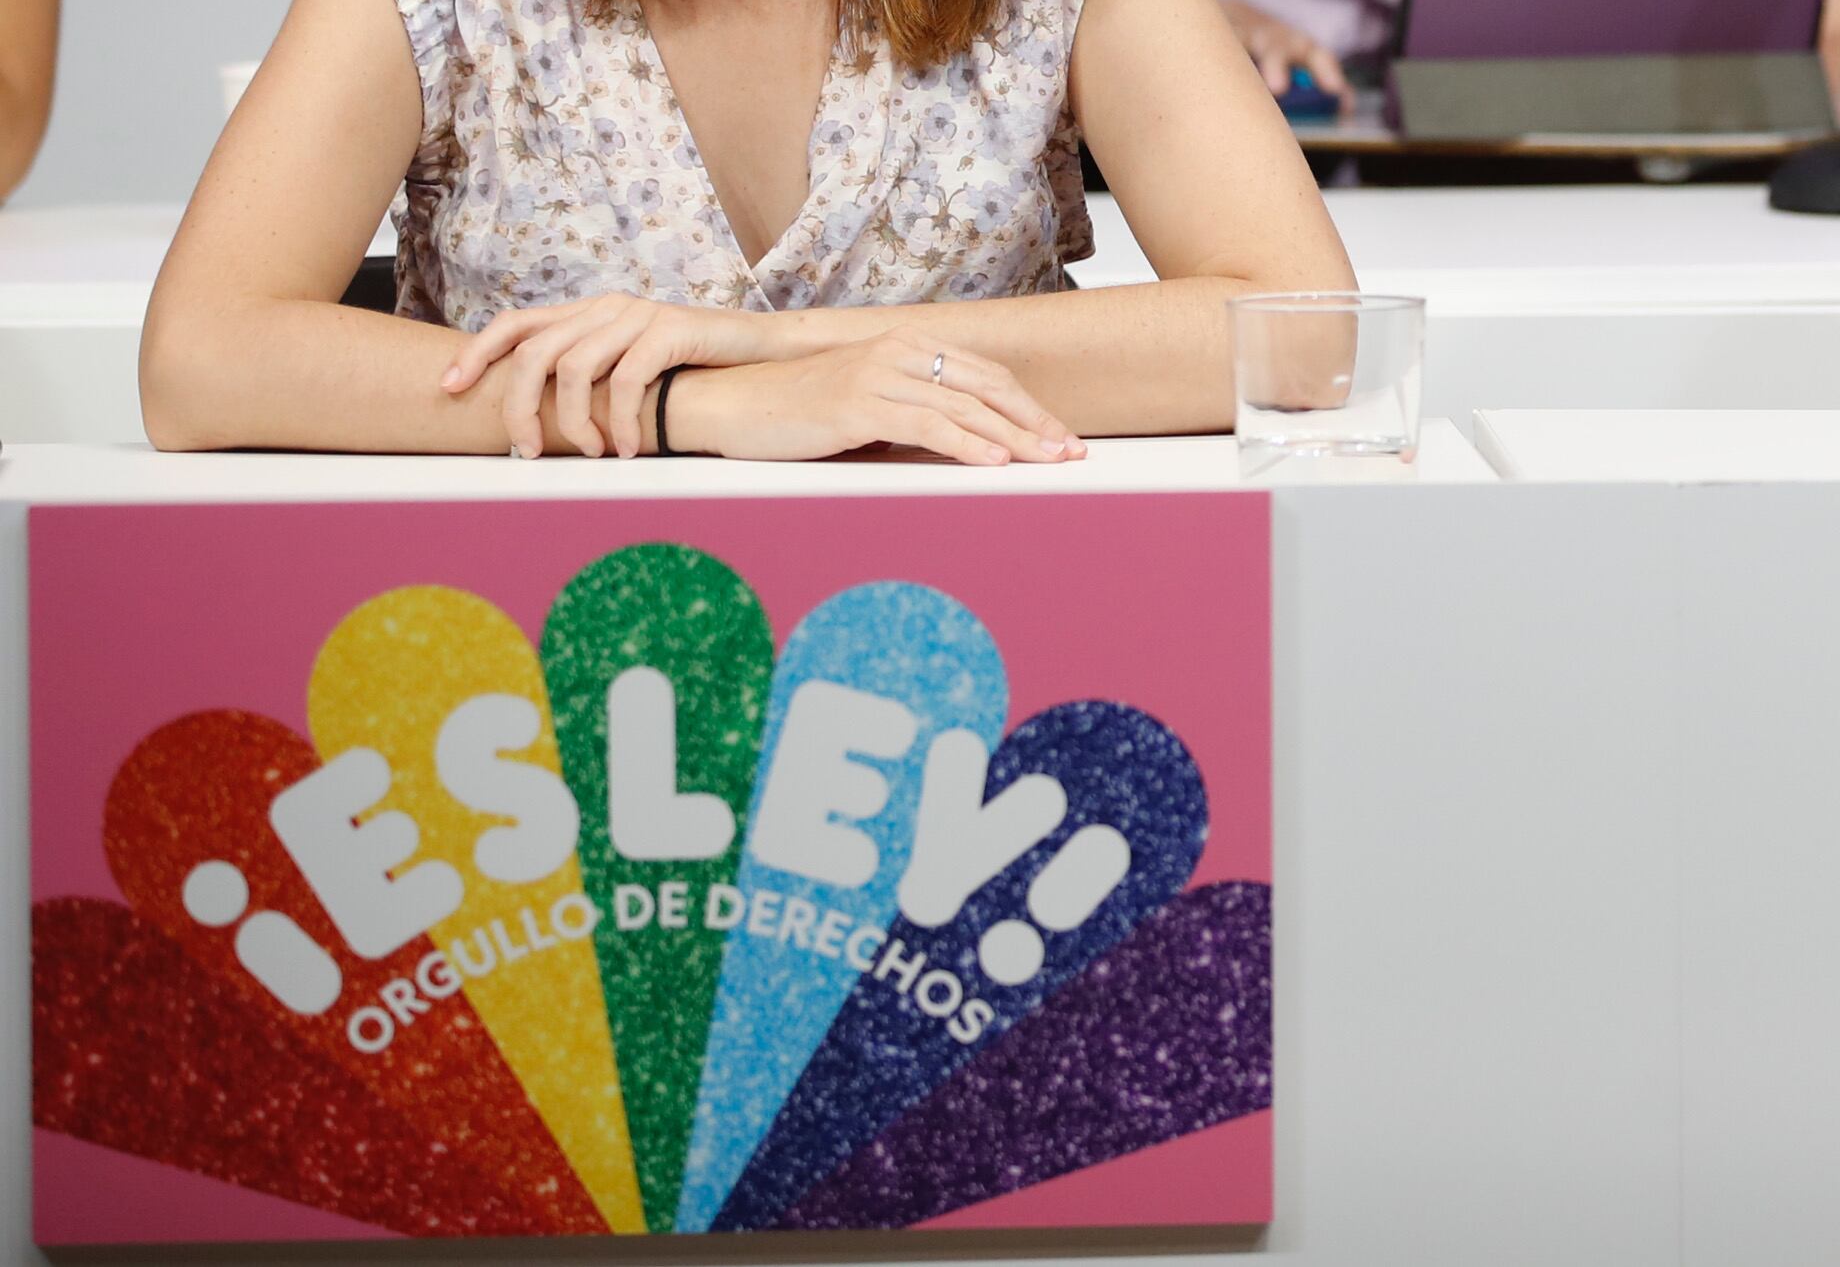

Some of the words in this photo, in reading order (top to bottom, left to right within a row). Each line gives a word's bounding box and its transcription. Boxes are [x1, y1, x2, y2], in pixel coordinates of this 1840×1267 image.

[346, 892, 599, 1053] ORGULLO
[613, 882, 690, 932] DE
[704, 883, 994, 1046] DERECHOS
